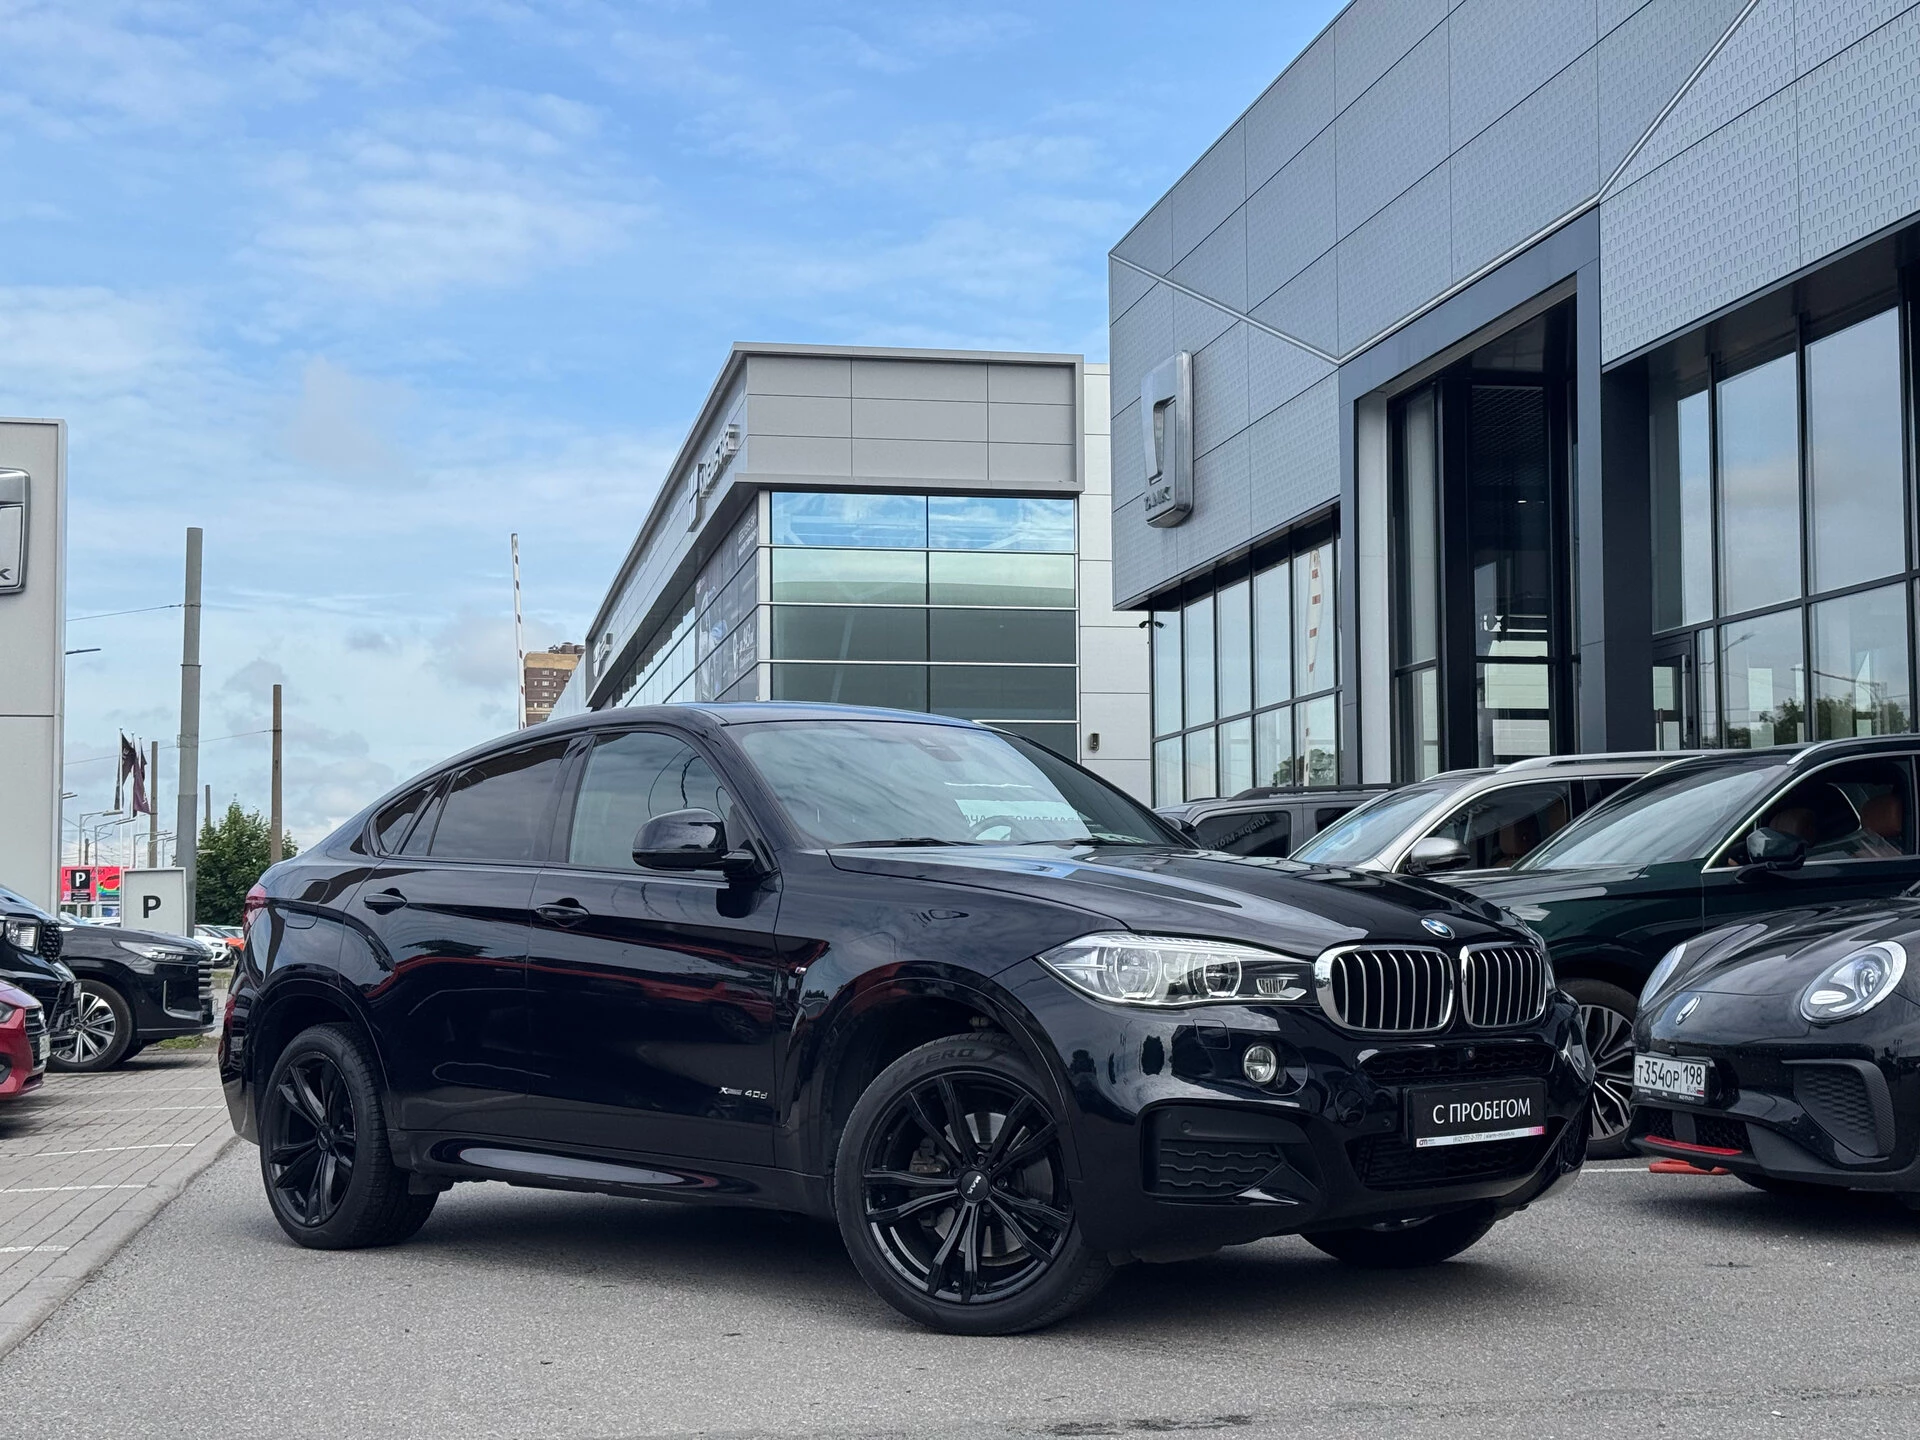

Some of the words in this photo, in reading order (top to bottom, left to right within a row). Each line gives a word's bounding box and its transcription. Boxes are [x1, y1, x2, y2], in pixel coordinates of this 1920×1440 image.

[75, 872, 86, 887] P
[143, 895, 161, 918] P
[1683, 1064, 1703, 1086] 198
[1433, 1105, 1445, 1124] С
[1449, 1097, 1531, 1123] ПРОБЕГОМ
